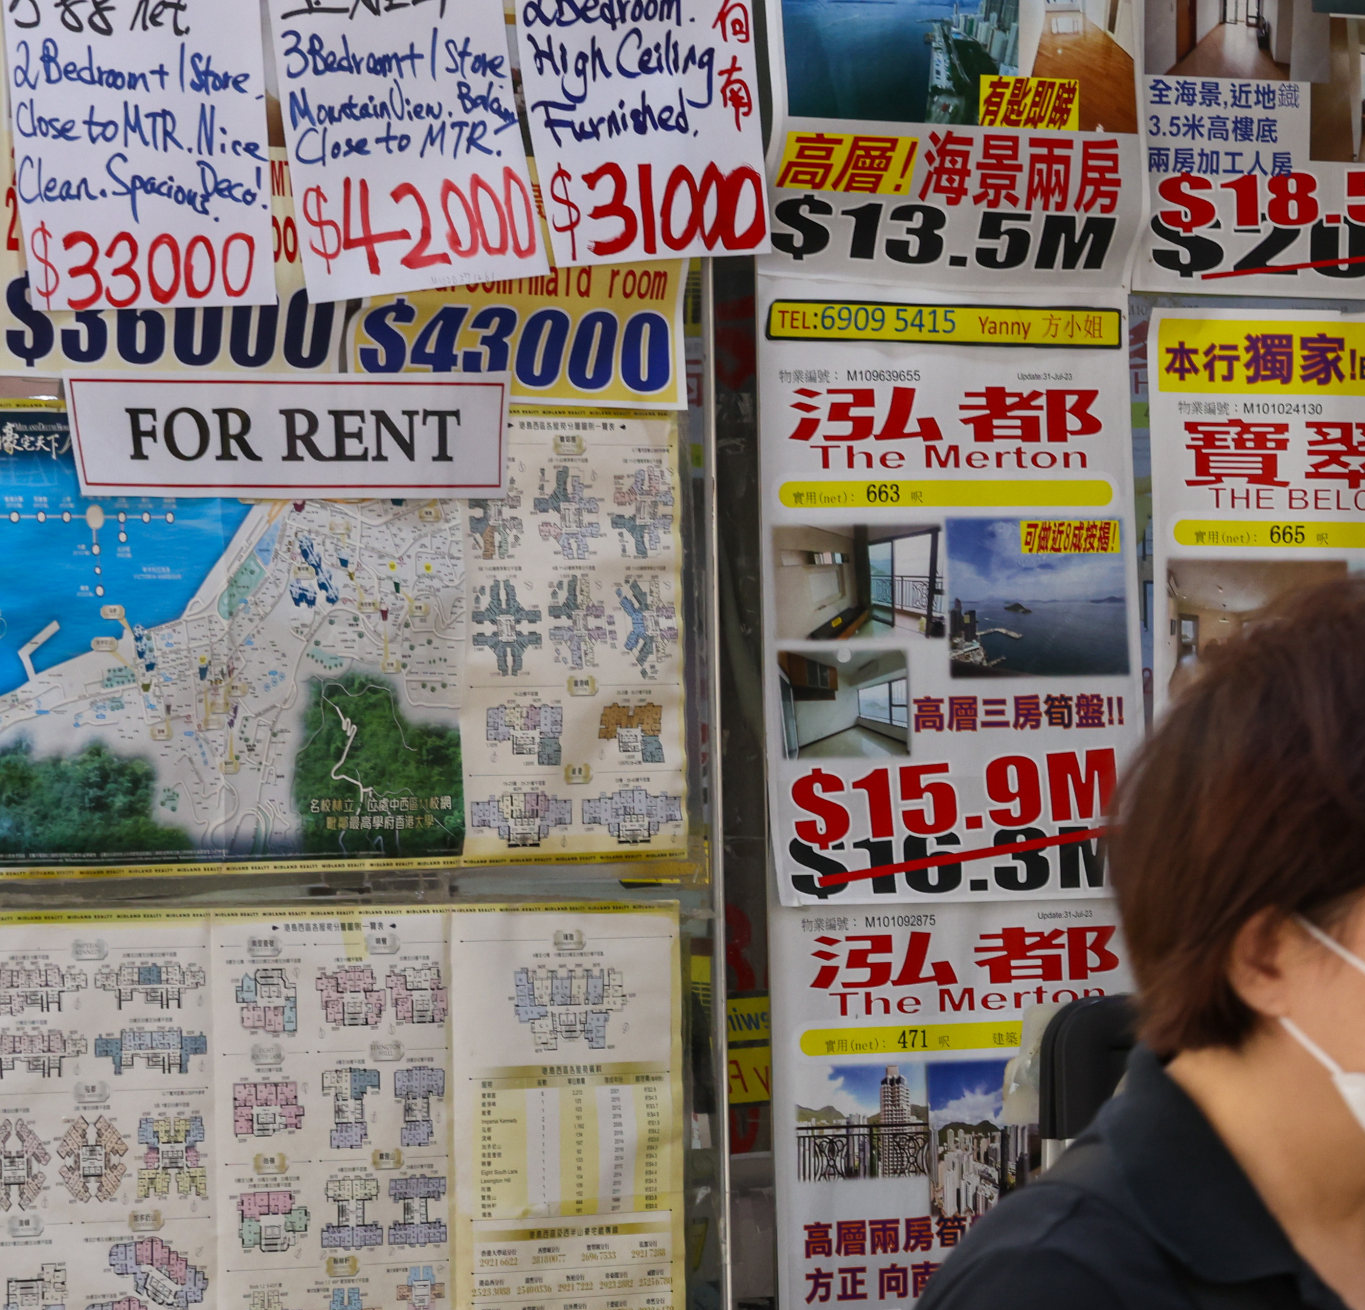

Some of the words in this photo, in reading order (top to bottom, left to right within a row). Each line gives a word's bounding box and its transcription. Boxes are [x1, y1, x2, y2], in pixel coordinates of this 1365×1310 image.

[529, 33, 608, 103] High
[614, 30, 715, 108] Ceiling
[982, 77, 1079, 129] 有匙即睇
[16, 98, 90, 140] Close
[89, 103, 122, 147] to
[196, 105, 269, 162] Nice
[296, 128, 369, 166] Close
[1148, 116, 1279, 144] 3.5米高樓底
[922, 132, 1122, 212] 海景兩房
[1148, 146, 1293, 177] 兩房加工人房
[302, 167, 538, 277] $42000
[549, 158, 768, 262] $31000
[769, 195, 1117, 271] $13.5M
[31, 221, 257, 309] $33000
[5, 273, 335, 369] $36000
[359, 297, 672, 394] $43000
[895, 308, 957, 334] 5415
[978, 315, 1033, 340] Yanny
[1041, 314, 1103, 341] 方小姐
[126, 405, 261, 462] FOR
[281, 406, 462, 461] RENT
[810, 443, 902, 470] The
[941, 443, 1089, 470] Merton
[865, 483, 902, 504] 663
[1209, 487, 1283, 512] THE
[1022, 520, 1119, 554] 可做近8成按揭!
[1270, 525, 1306, 544] 665
[912, 695, 1125, 733] 高層三房筍盤!!
[791, 748, 1118, 849] $15.9M
[789, 827, 1110, 898] $16.3M
[829, 991, 922, 1017] The
[897, 1029, 929, 1050] 471
